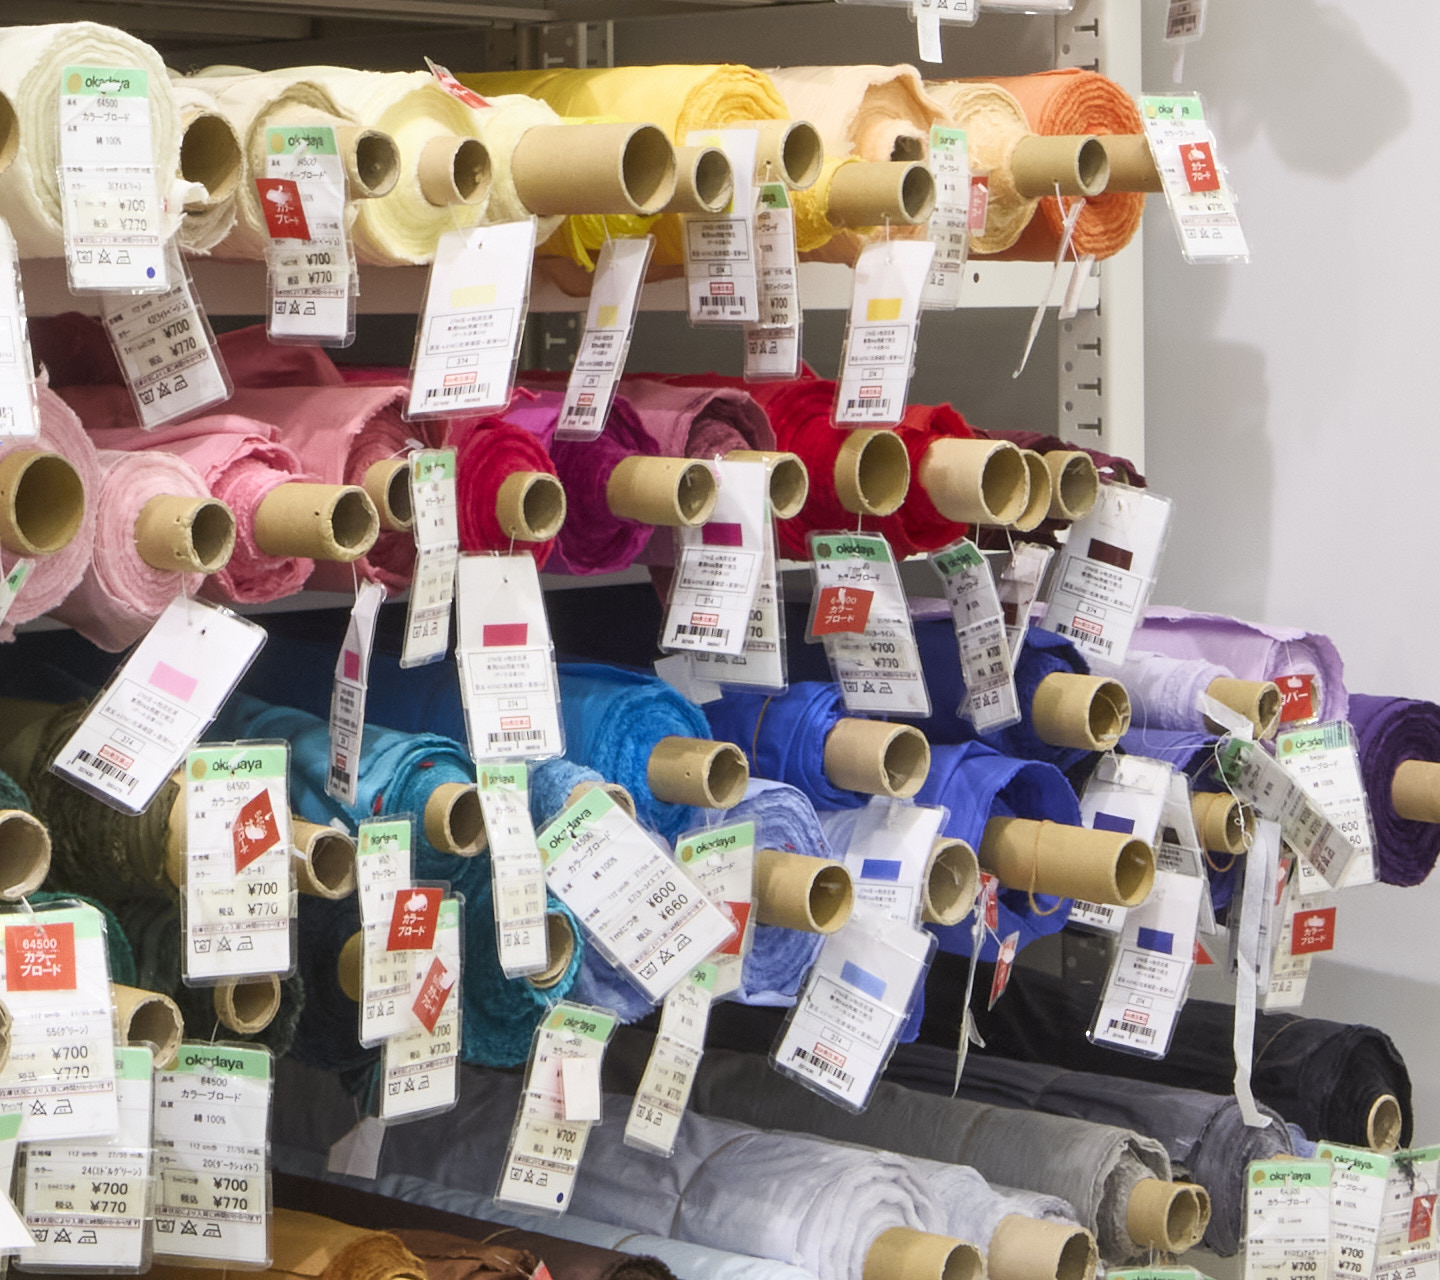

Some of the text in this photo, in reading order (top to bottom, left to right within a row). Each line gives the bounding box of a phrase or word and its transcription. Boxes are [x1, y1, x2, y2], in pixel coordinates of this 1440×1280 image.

[306, 252, 331, 266] ¥700
[308, 271, 333, 284] ¥770
[871, 642, 895, 654] ¥700
[874, 657, 899, 669] ¥770
[646, 881, 676, 909] ¥600
[658, 893, 689, 921] ¥660
[1291, 1262, 1317, 1271] ¥700
